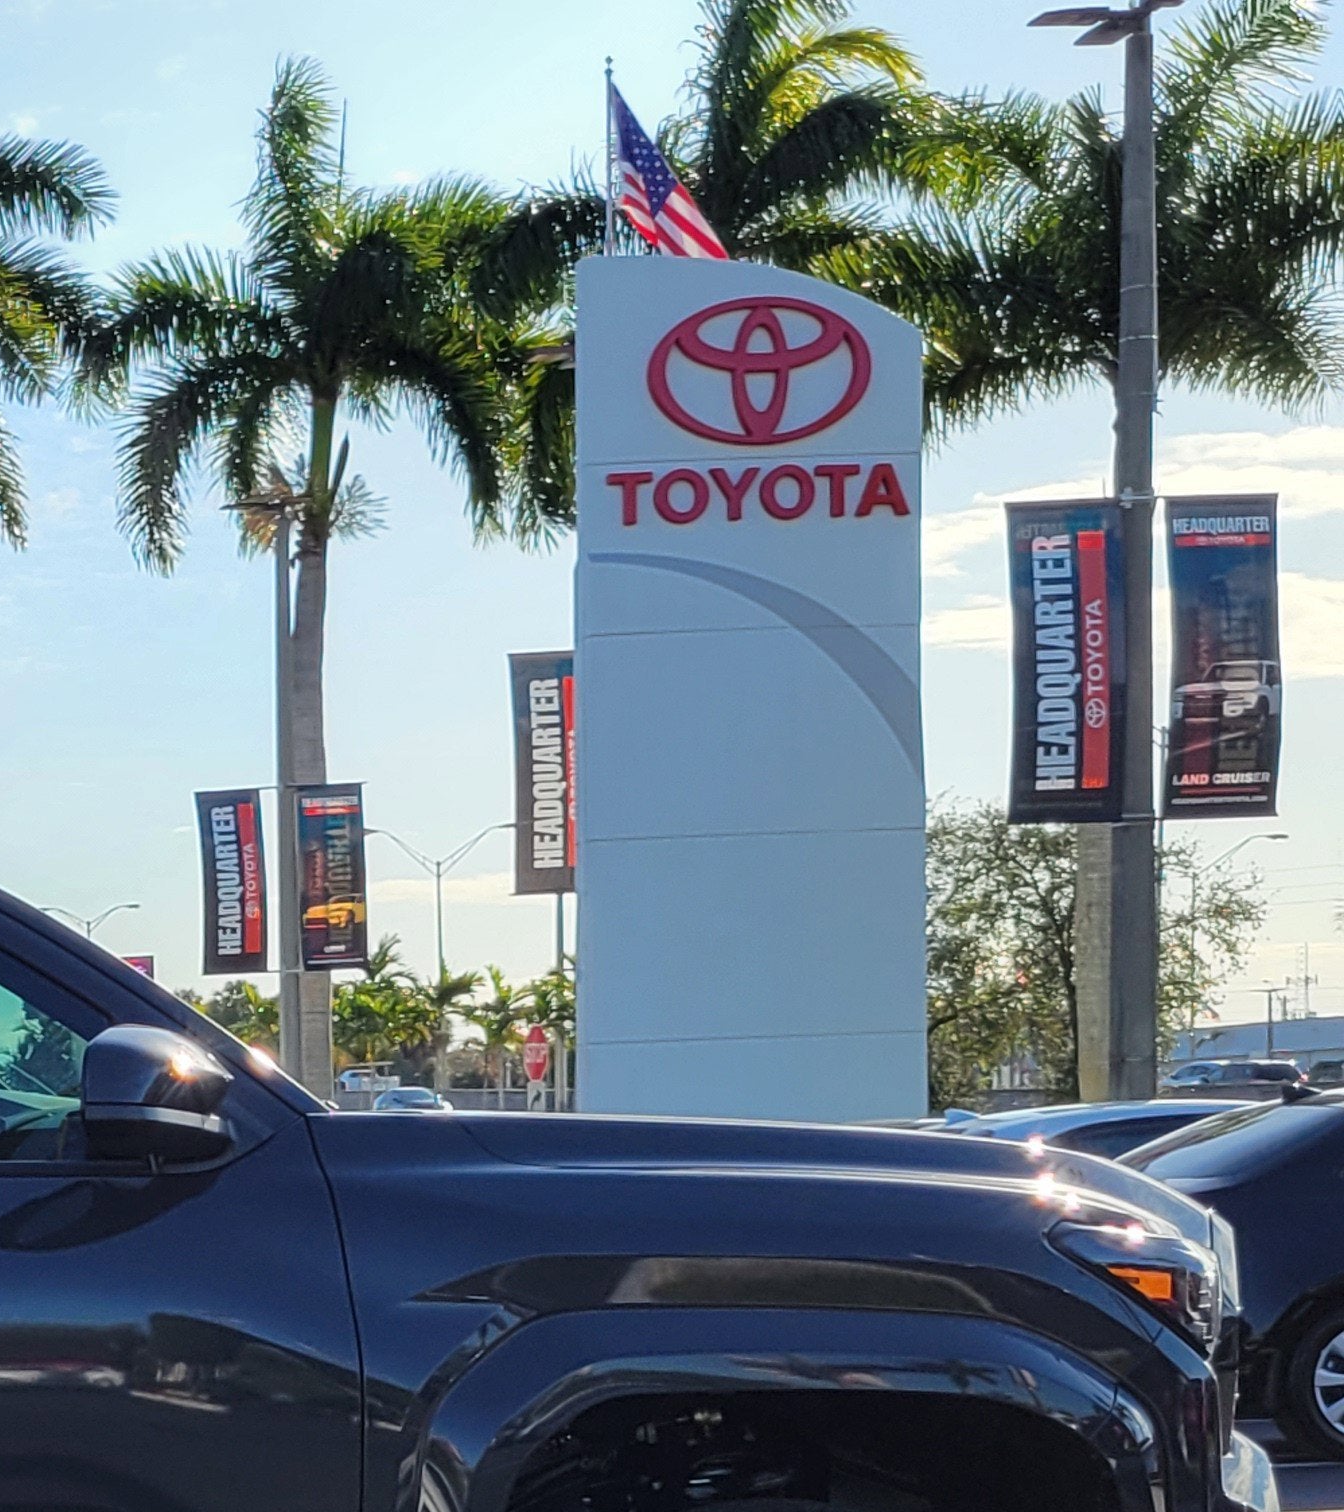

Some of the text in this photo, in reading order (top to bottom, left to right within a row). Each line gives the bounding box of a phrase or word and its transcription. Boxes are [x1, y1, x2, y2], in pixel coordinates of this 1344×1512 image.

[605, 463, 911, 526] TOYOTA
[1173, 516, 1270, 535] HEADQUARTER
[1031, 534, 1081, 791] HEADQUARTER
[1085, 599, 1105, 696] TOYOTA
[530, 678, 566, 869] HEADQUARTER
[1172, 772, 1270, 786] LAND CRUISER
[211, 805, 243, 955] HEADQUARTER
[243, 843, 257, 900] TOYOTA
